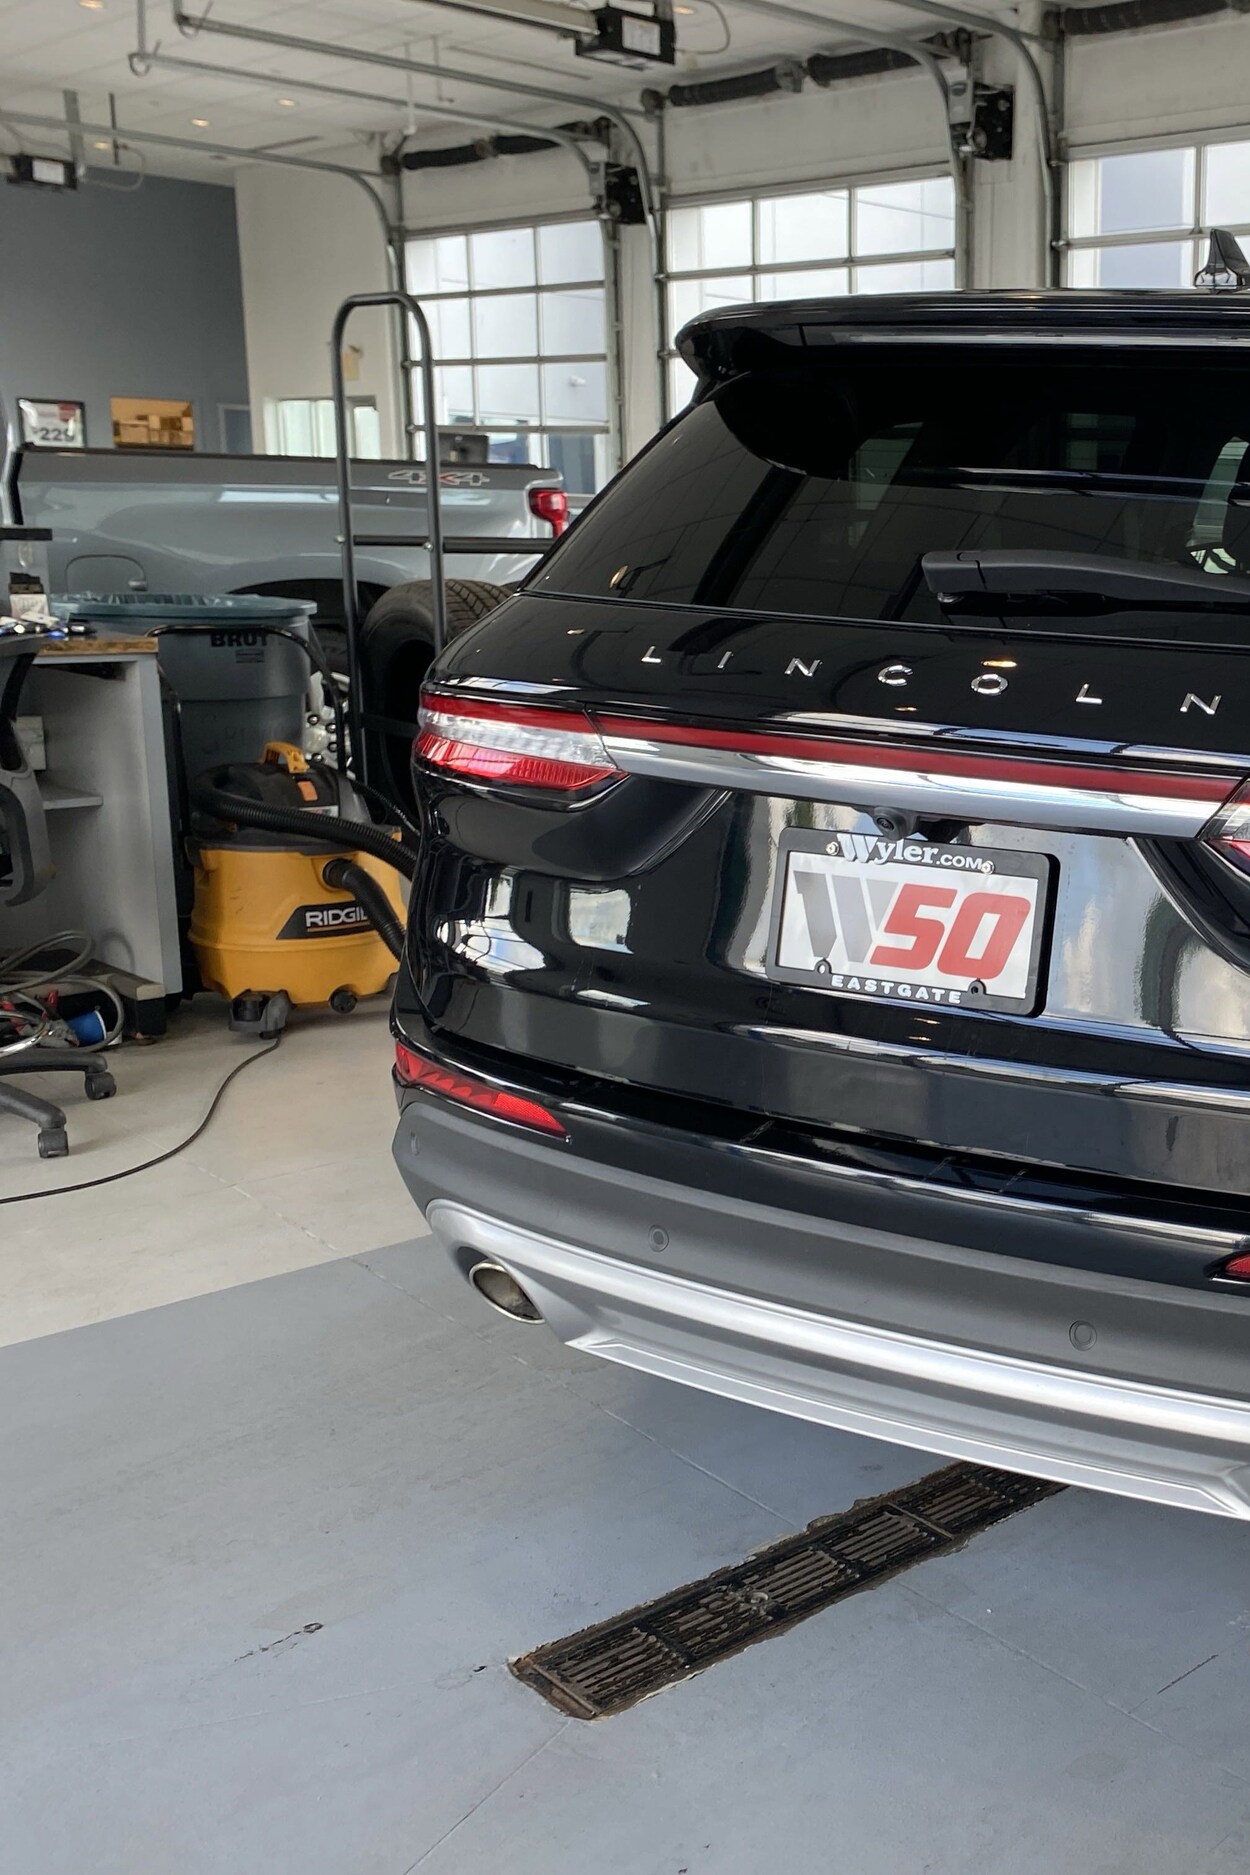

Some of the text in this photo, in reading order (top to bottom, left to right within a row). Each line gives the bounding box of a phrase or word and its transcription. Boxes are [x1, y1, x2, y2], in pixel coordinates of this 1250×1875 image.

[640, 644, 1223, 716] LINCOLN
[793, 870, 1031, 980] W50
[830, 974, 962, 1005] EASTGATE
